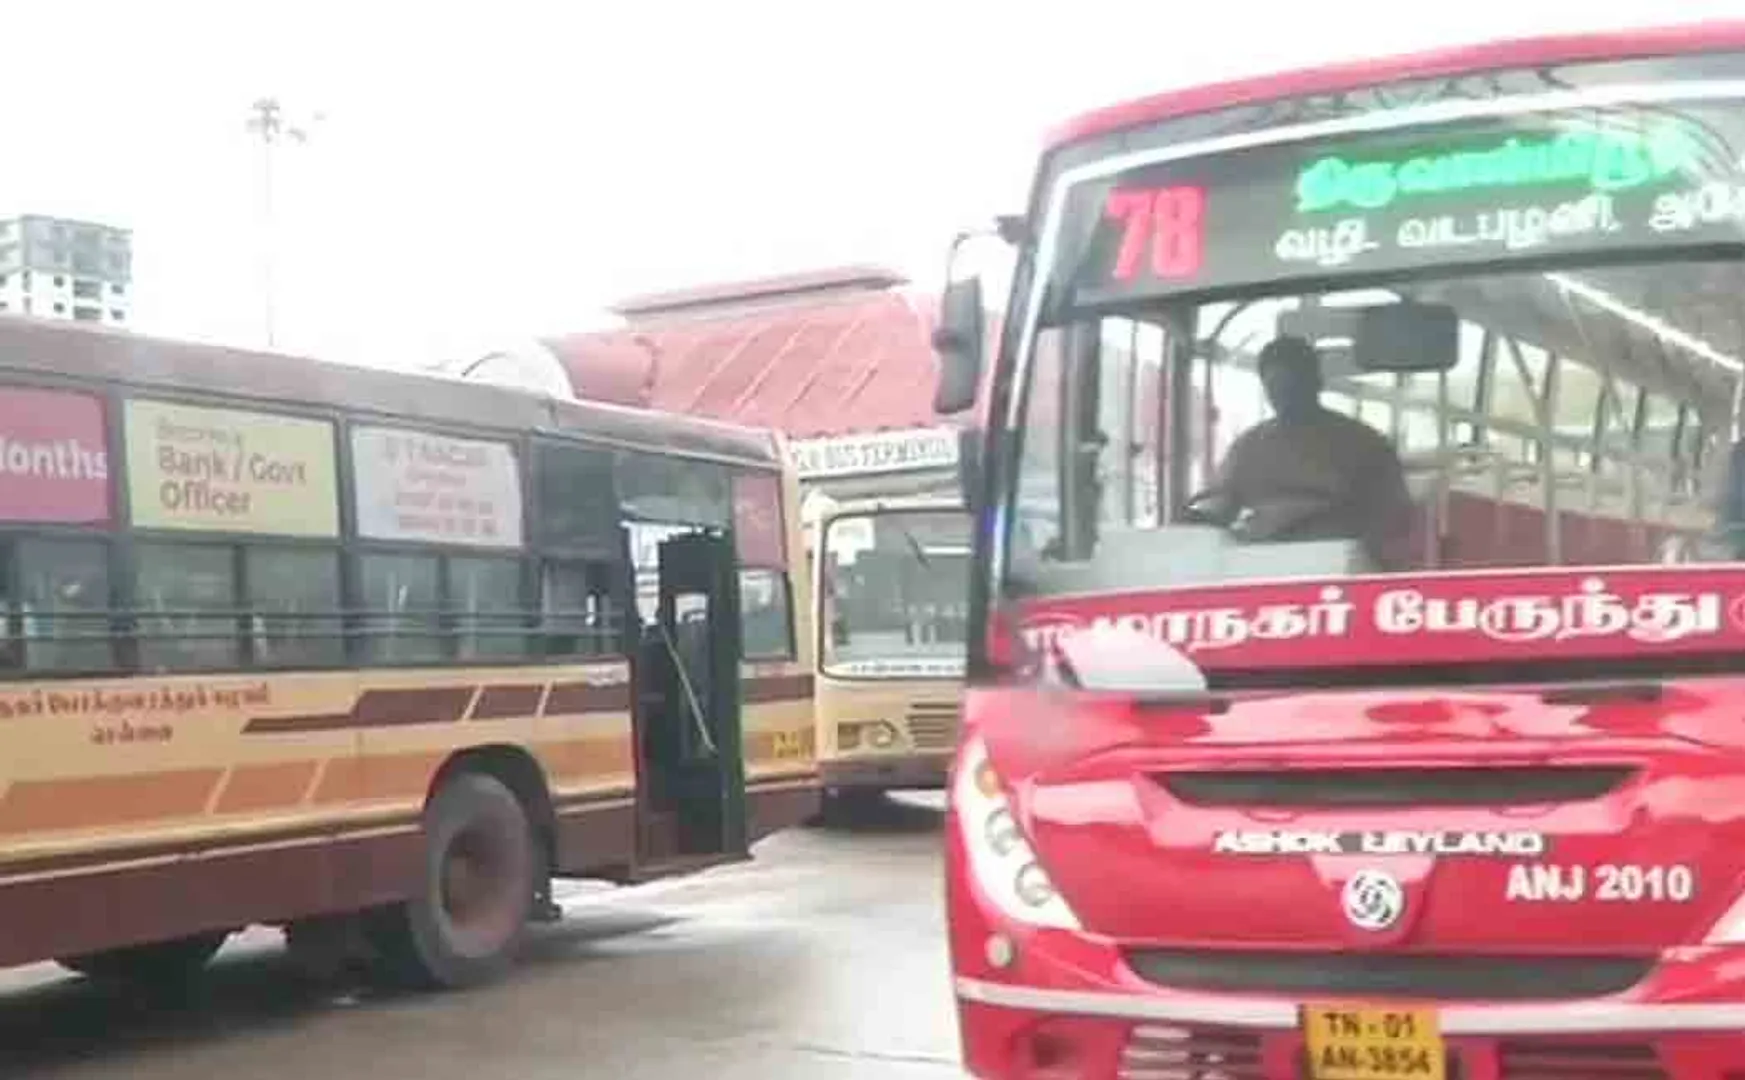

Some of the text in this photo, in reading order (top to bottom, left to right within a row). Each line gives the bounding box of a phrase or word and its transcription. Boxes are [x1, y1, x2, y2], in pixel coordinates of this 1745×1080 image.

[1104, 185, 1205, 280] 78
[0, 437, 108, 480] onths
[158, 443, 228, 480] Bank
[158, 479, 254, 516] Officer
[1374, 576, 1721, 644] பேருந்து
[1213, 829, 1545, 855] ASHOK LEYLAND
[1505, 866, 1692, 902] ANJ 2010
